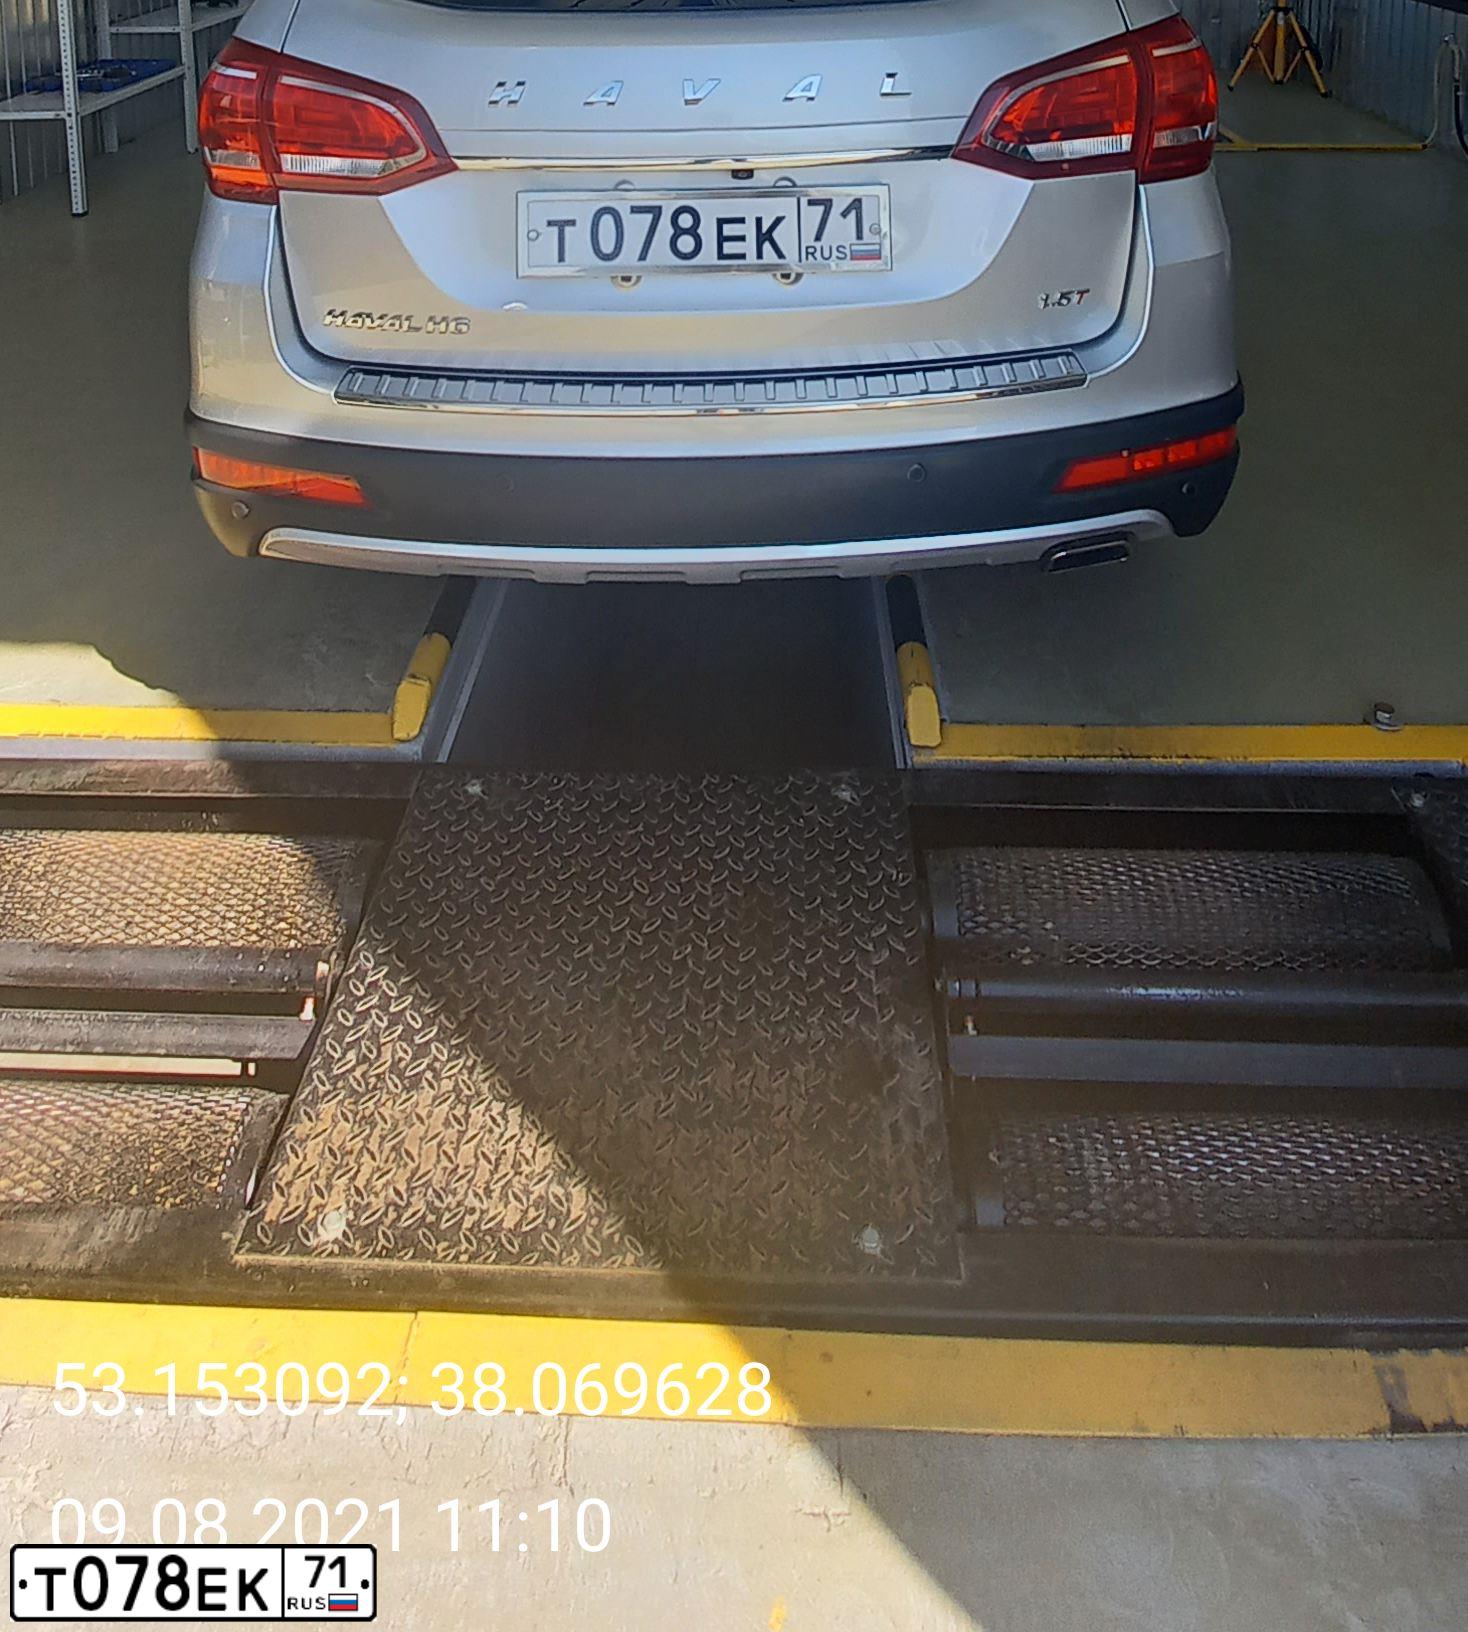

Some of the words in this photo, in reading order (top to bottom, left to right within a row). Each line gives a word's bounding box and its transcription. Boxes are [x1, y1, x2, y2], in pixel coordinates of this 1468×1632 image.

[488, 72, 911, 106] HAVAL
[807, 197, 864, 243] 71
[805, 244, 848, 262] RUS
[323, 309, 422, 333] HAVAL
